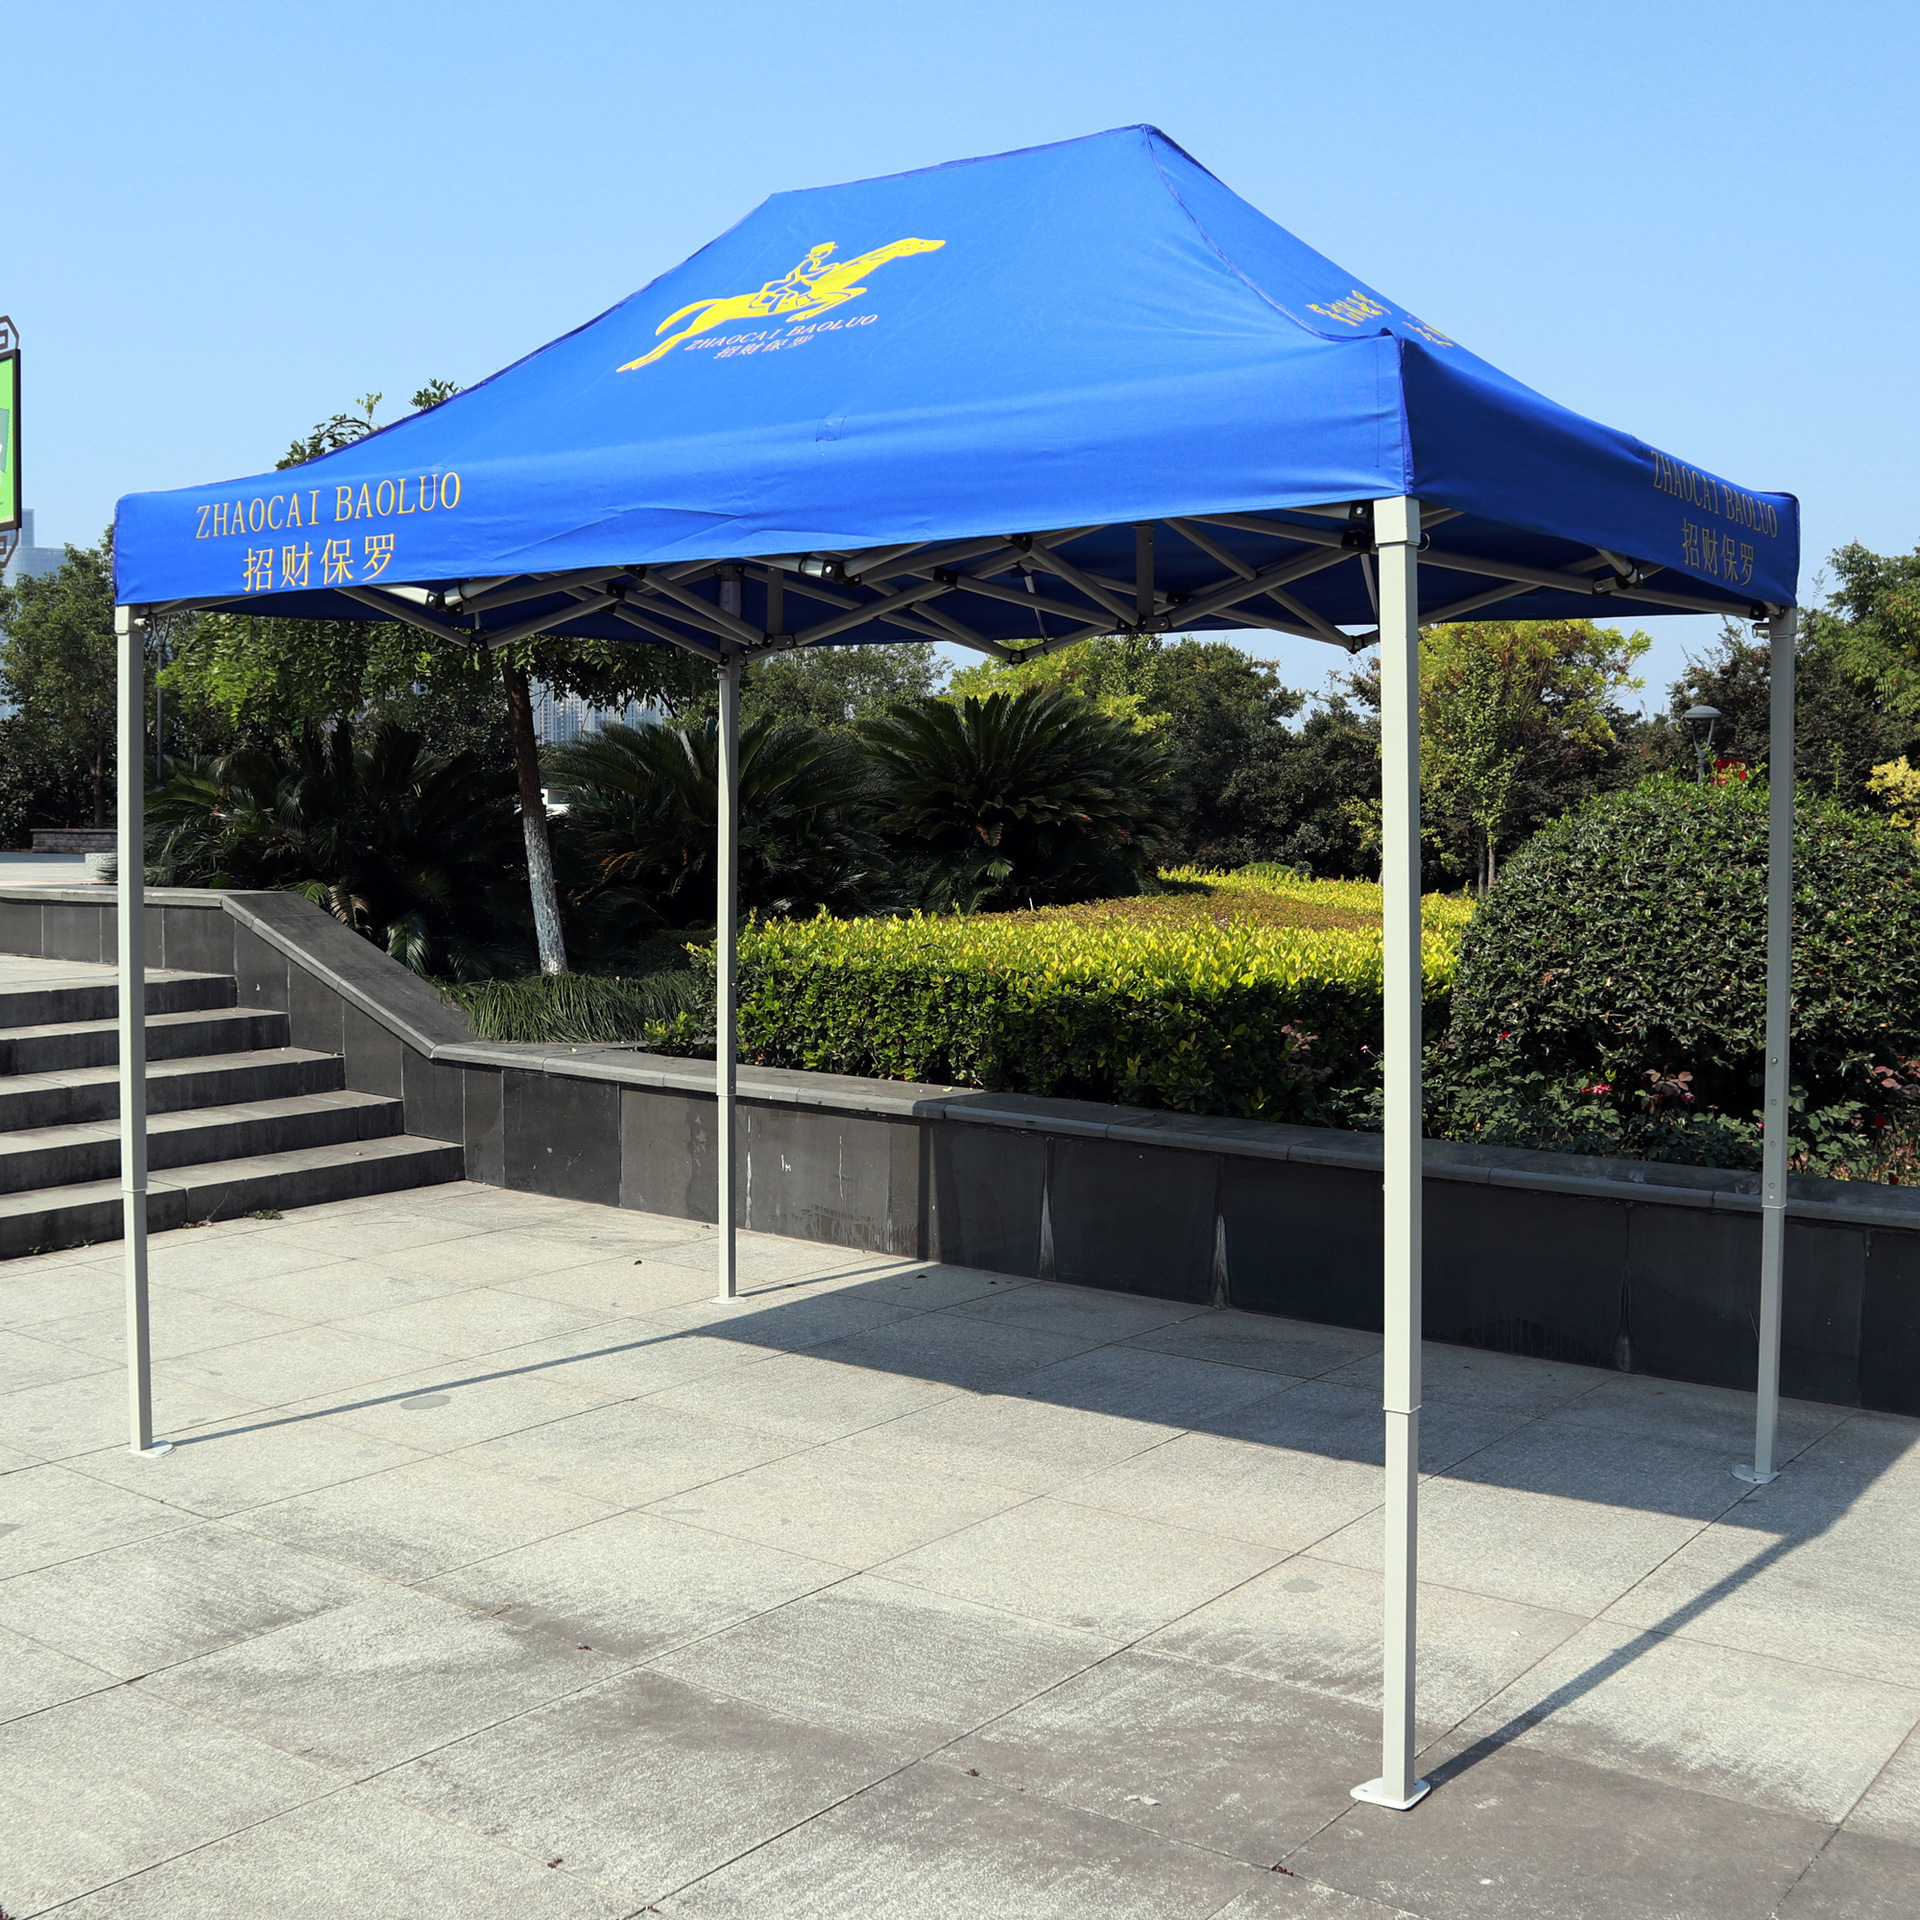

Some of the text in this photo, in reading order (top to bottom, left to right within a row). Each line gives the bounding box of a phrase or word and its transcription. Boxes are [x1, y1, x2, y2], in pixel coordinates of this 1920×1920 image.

[684, 314, 878, 351] ZHAOCAI BAOLUO
[195, 472, 461, 539] ZHAOCAI BAOLUO
[1650, 450, 1778, 538] ZHAOCAI BAOLUO
[242, 533, 396, 592] 招财保罗
[1681, 518, 1754, 586] 招财保罗
